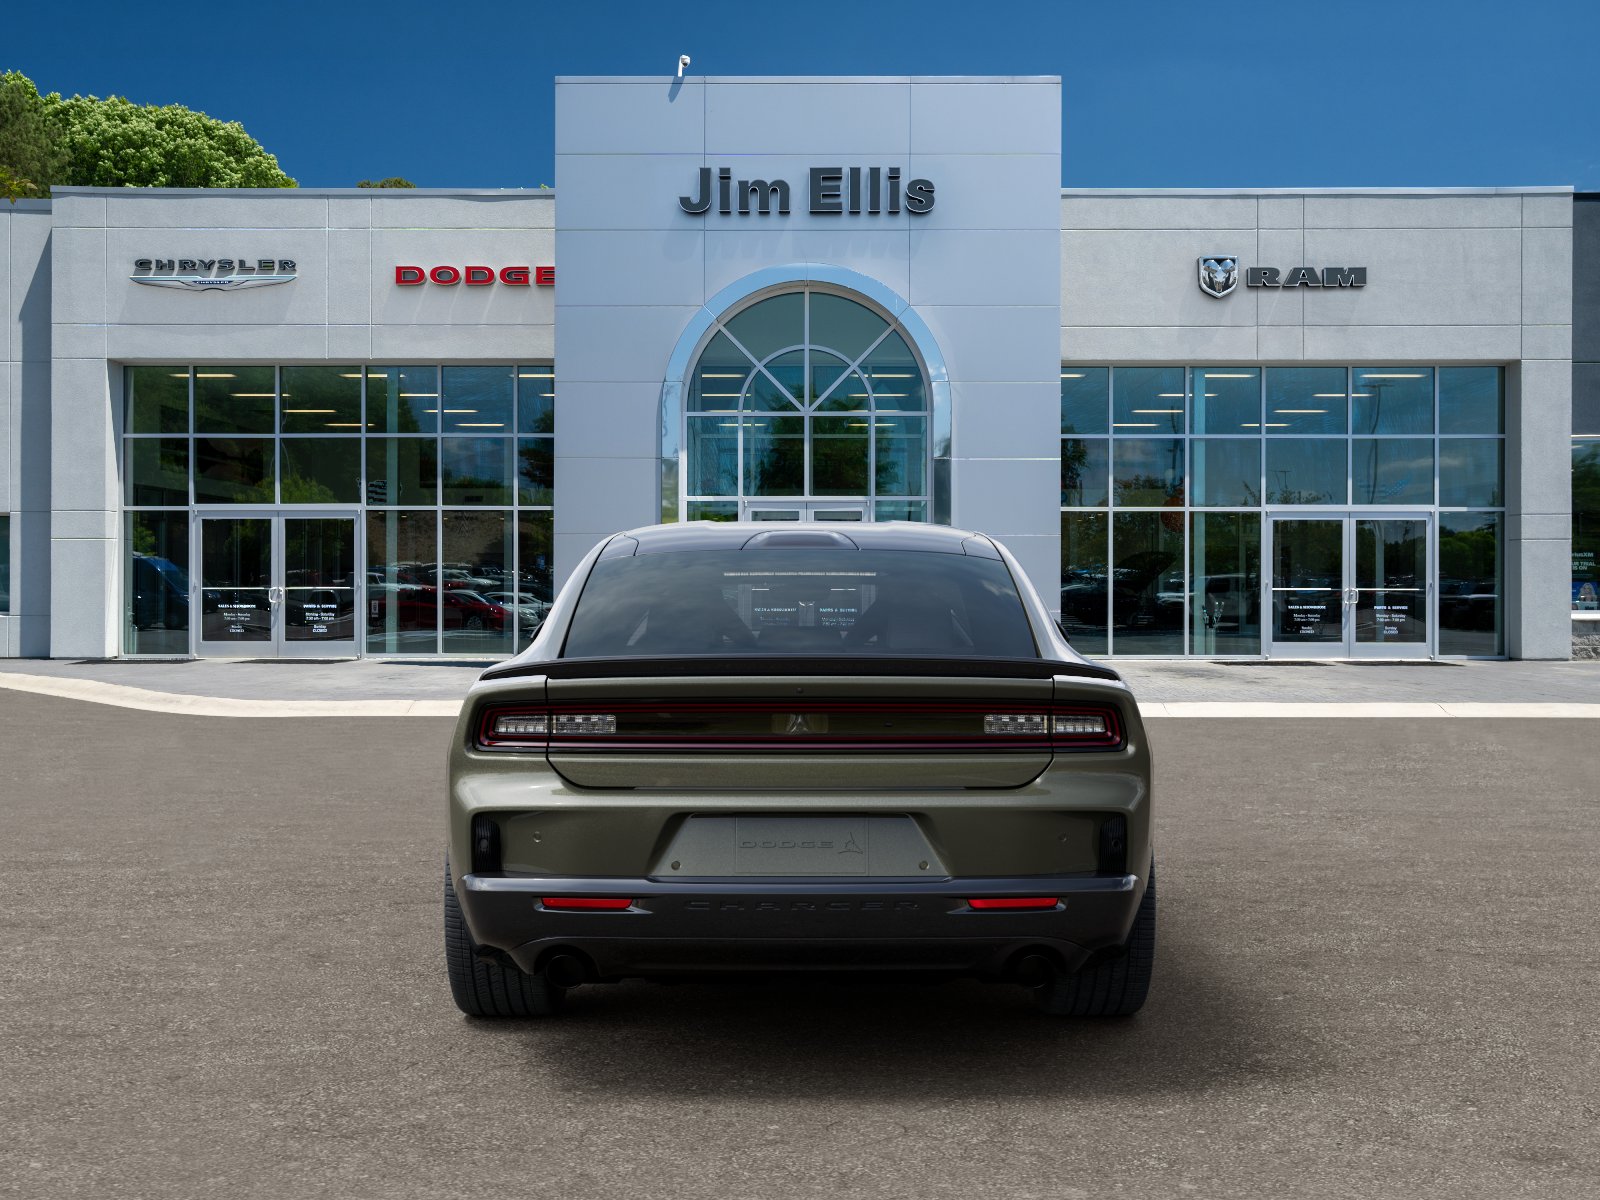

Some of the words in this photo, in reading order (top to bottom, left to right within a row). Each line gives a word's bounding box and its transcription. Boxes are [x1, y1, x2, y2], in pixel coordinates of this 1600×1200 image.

[678, 167, 790, 213] Jim
[809, 167, 935, 213] Ellis
[134, 258, 297, 270] CHRYSLER
[396, 265, 555, 286] DODGE
[1247, 267, 1367, 287] RAM
[739, 841, 834, 849] DODGE
[685, 900, 920, 911] CHARGER
